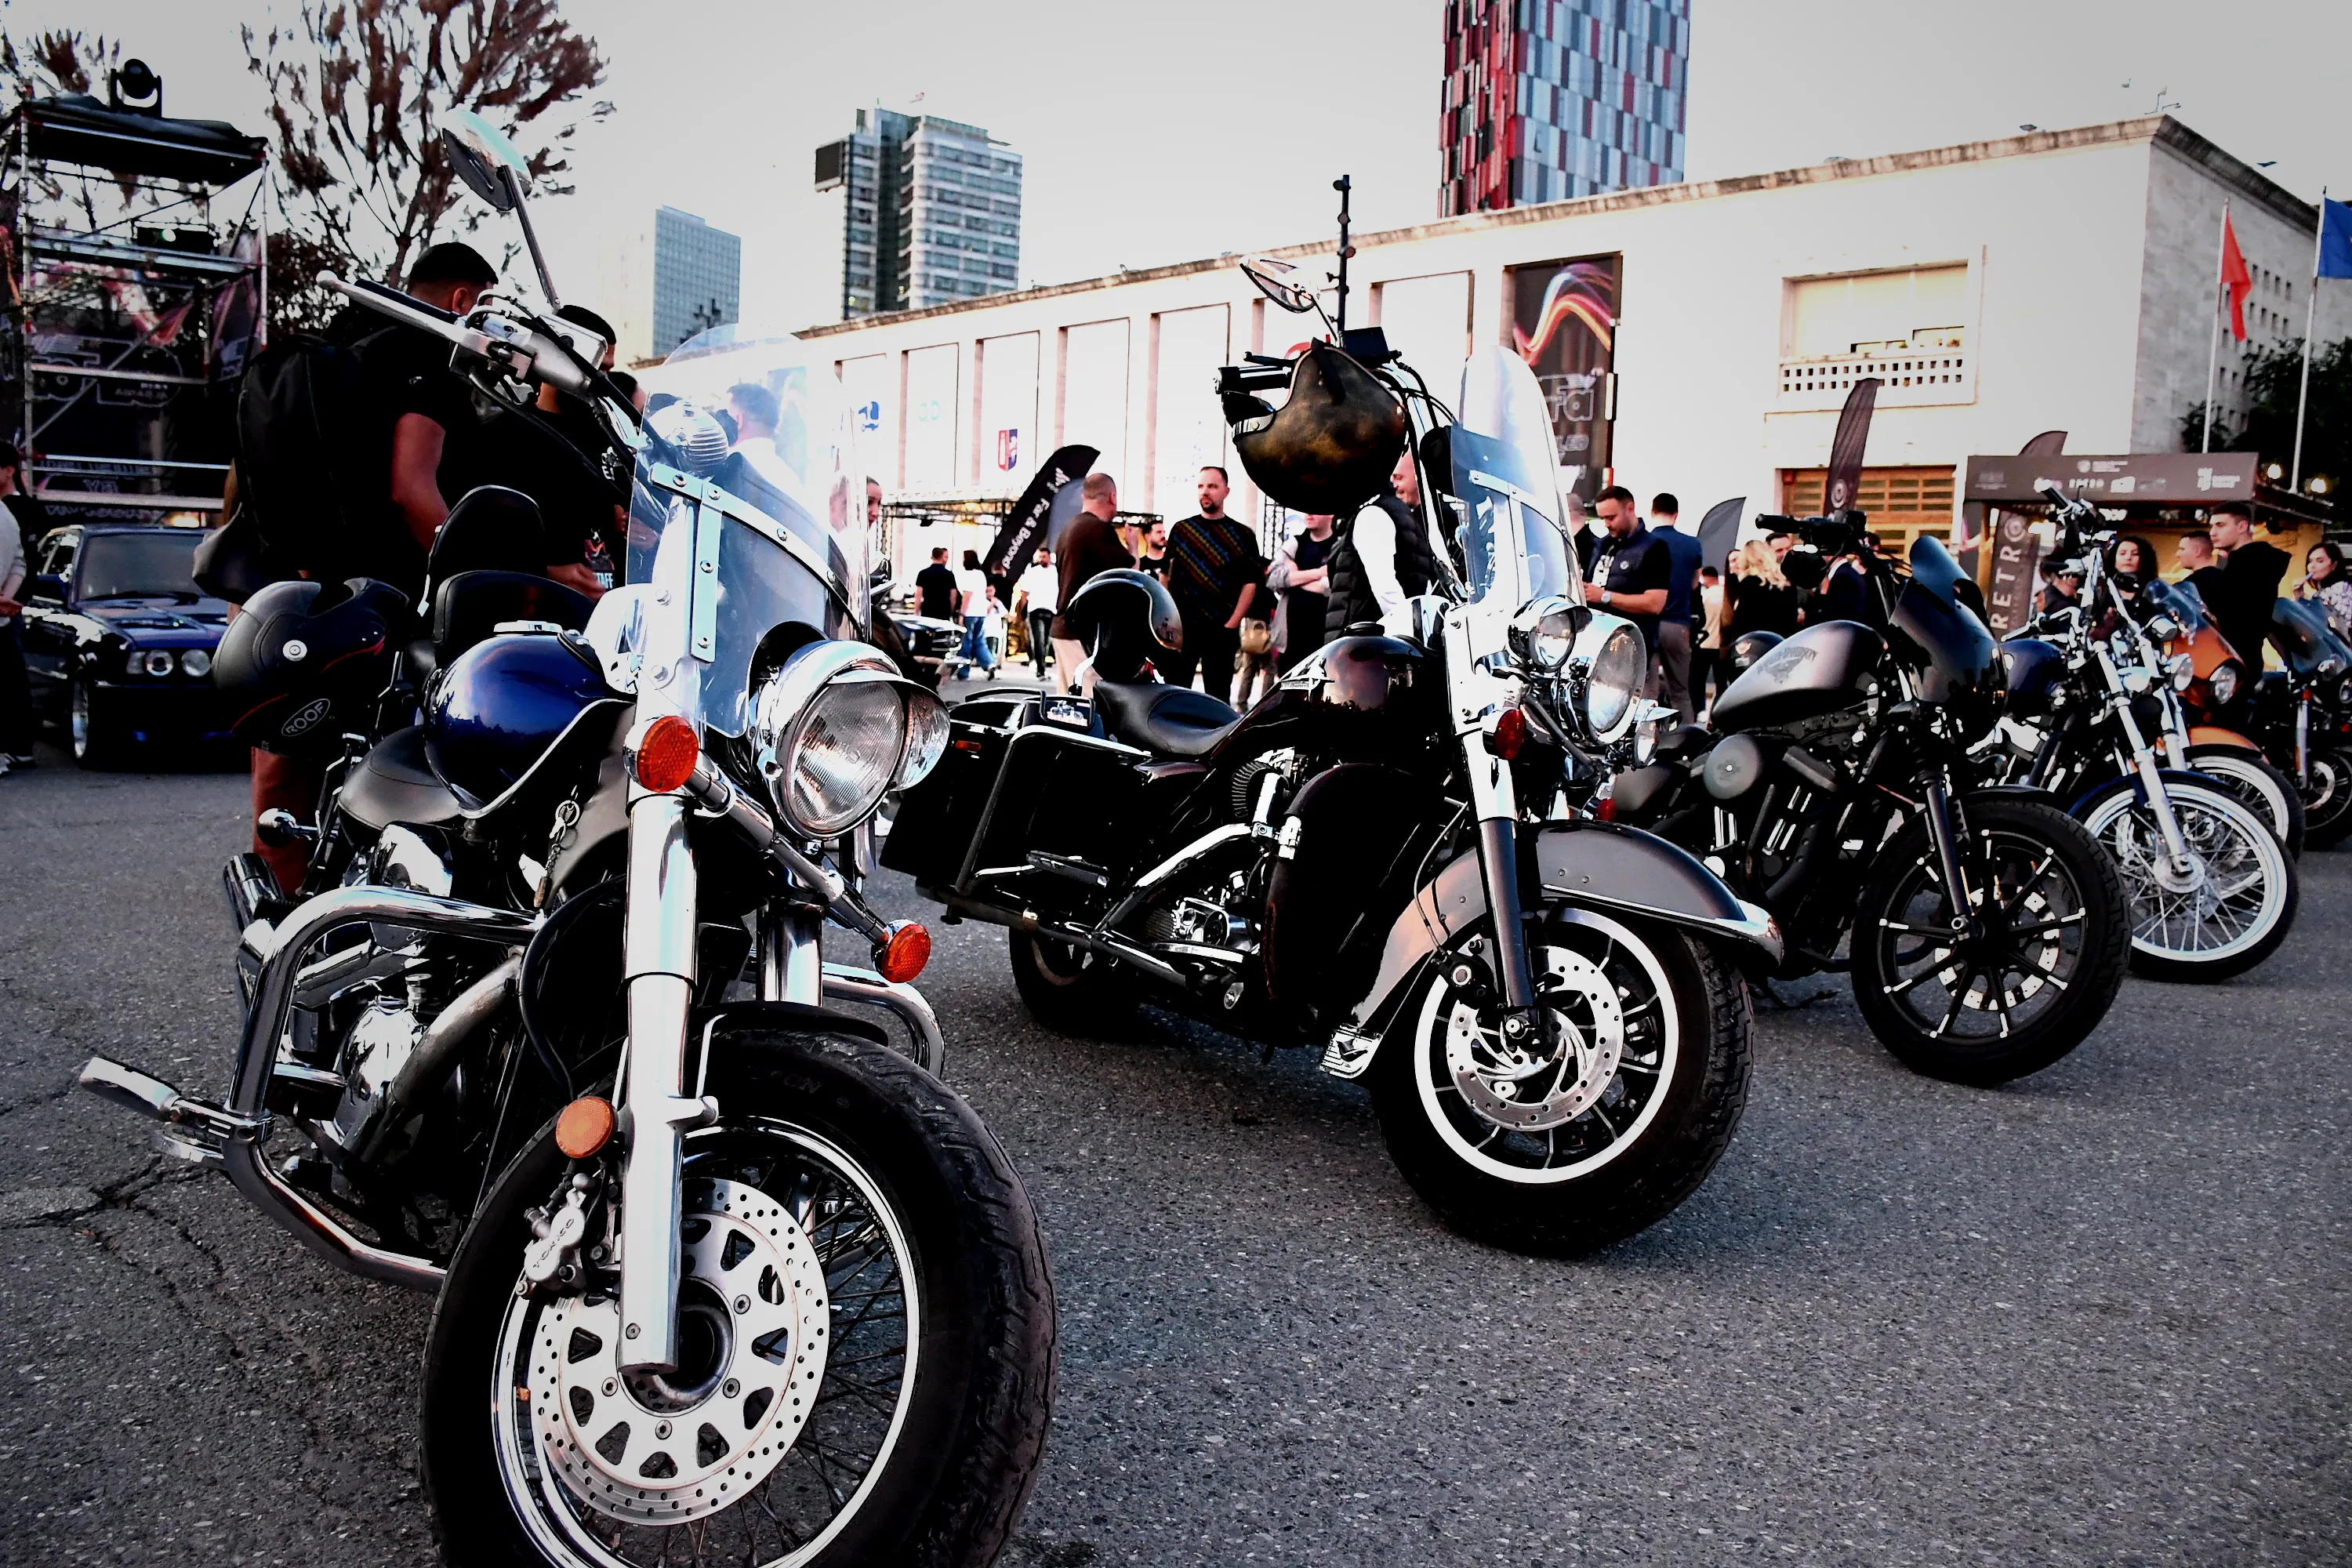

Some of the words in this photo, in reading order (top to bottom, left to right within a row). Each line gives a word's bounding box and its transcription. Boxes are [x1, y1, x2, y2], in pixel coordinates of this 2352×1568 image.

[1033, 498, 1051, 519] Far
[1025, 516, 1037, 528] &
[1002, 526, 1031, 570] Beyond
[285, 702, 324, 734] ROOF
[867, 1207, 884, 1228] JAPAN
[533, 1218, 575, 1269] TOKICO
